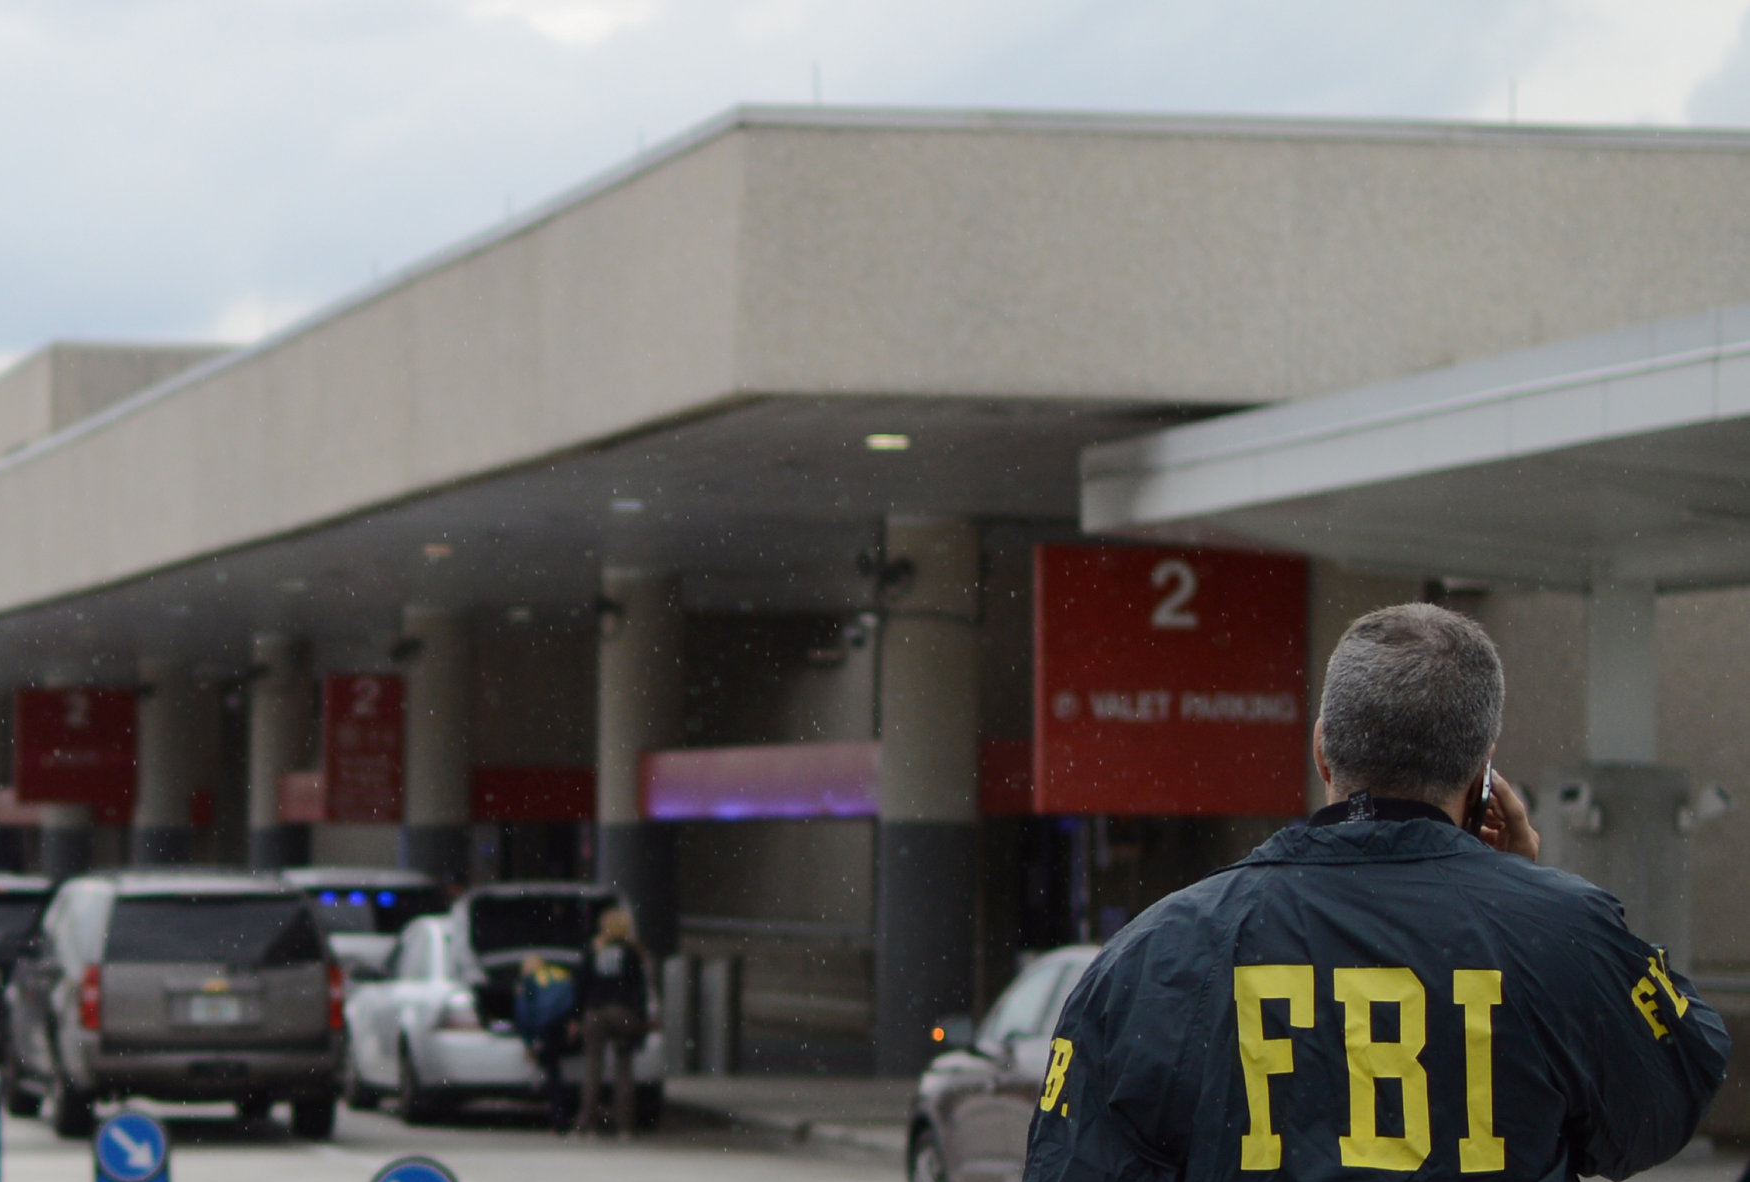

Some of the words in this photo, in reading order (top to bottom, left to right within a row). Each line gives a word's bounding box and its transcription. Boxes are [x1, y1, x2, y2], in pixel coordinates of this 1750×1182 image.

[1152, 559, 1198, 629] 2
[1089, 692, 1171, 721] VALET
[1180, 693, 1298, 723] PARKING
[1234, 965, 1505, 1173] FBI
